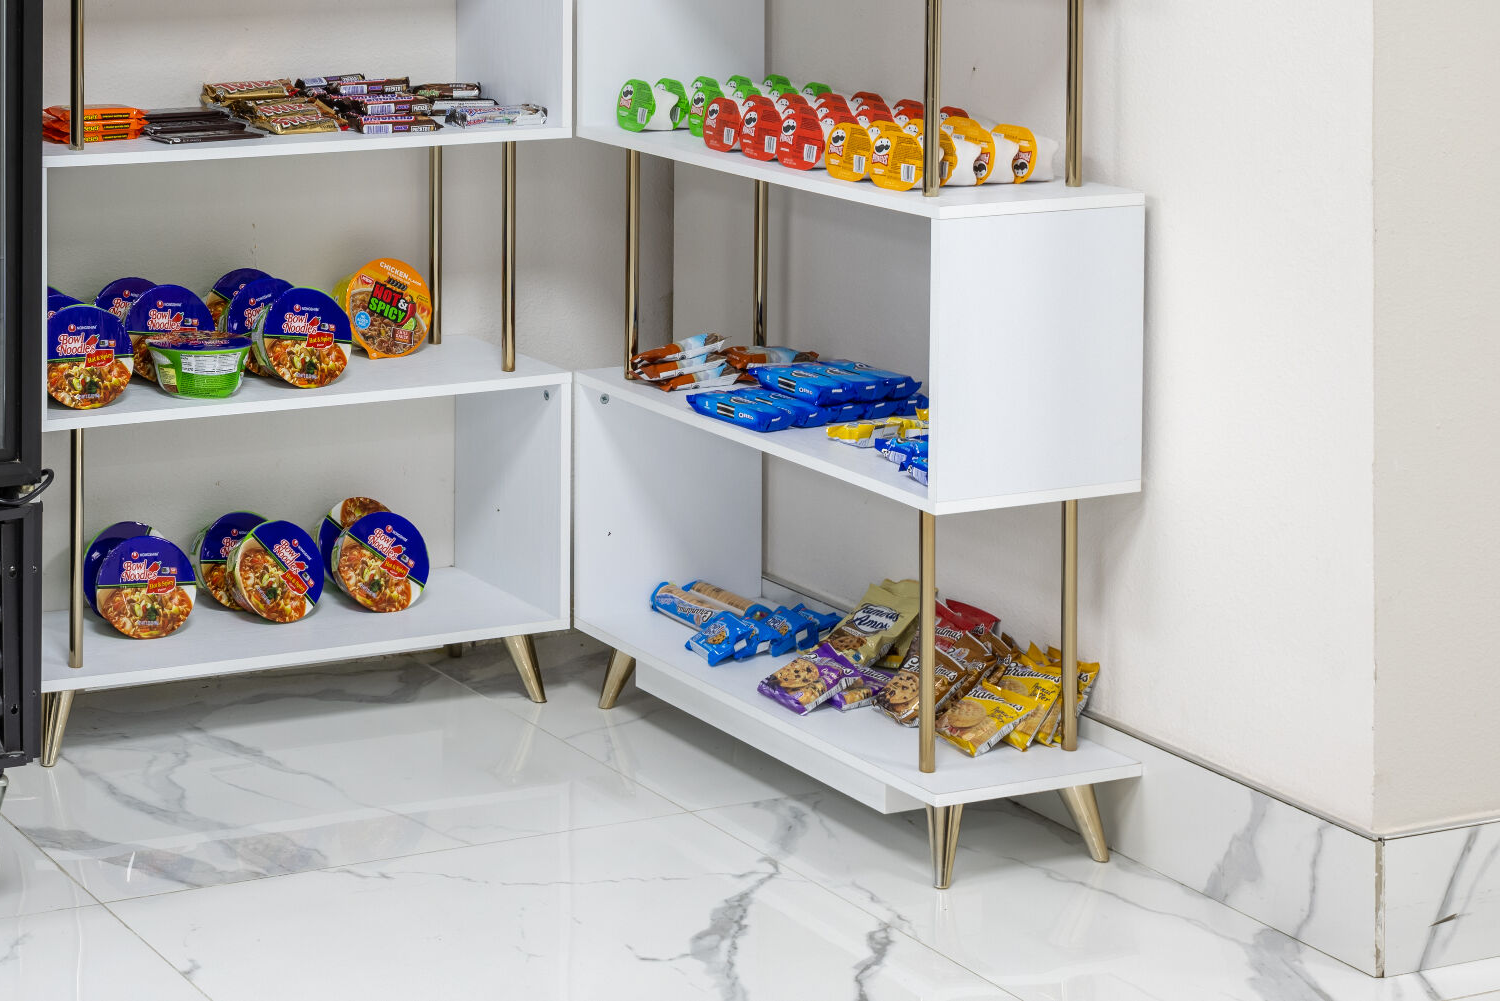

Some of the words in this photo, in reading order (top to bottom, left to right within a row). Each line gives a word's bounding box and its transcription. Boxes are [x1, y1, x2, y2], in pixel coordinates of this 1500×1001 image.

[379, 261, 409, 280] CHICKEN
[373, 283, 403, 307] HOT
[397, 298, 408, 311] &
[149, 309, 171, 320] Bowl
[284, 312, 309, 324] Bowl
[368, 297, 406, 323] SPICY
[147, 318, 181, 331] Noodles
[282, 322, 318, 334] Noodles
[58, 332, 85, 345] Bowl
[56, 342, 97, 356] Noodles
[373, 527, 397, 548] Bowl
[280, 538, 301, 561] Bowl
[367, 534, 399, 561] Noodles
[123, 559, 148, 571] Bowl
[273, 543, 301, 576] Noodles
[121, 570, 158, 582] Noodles
[860, 603, 901, 624] Famous
[852, 614, 891, 632] Amos
